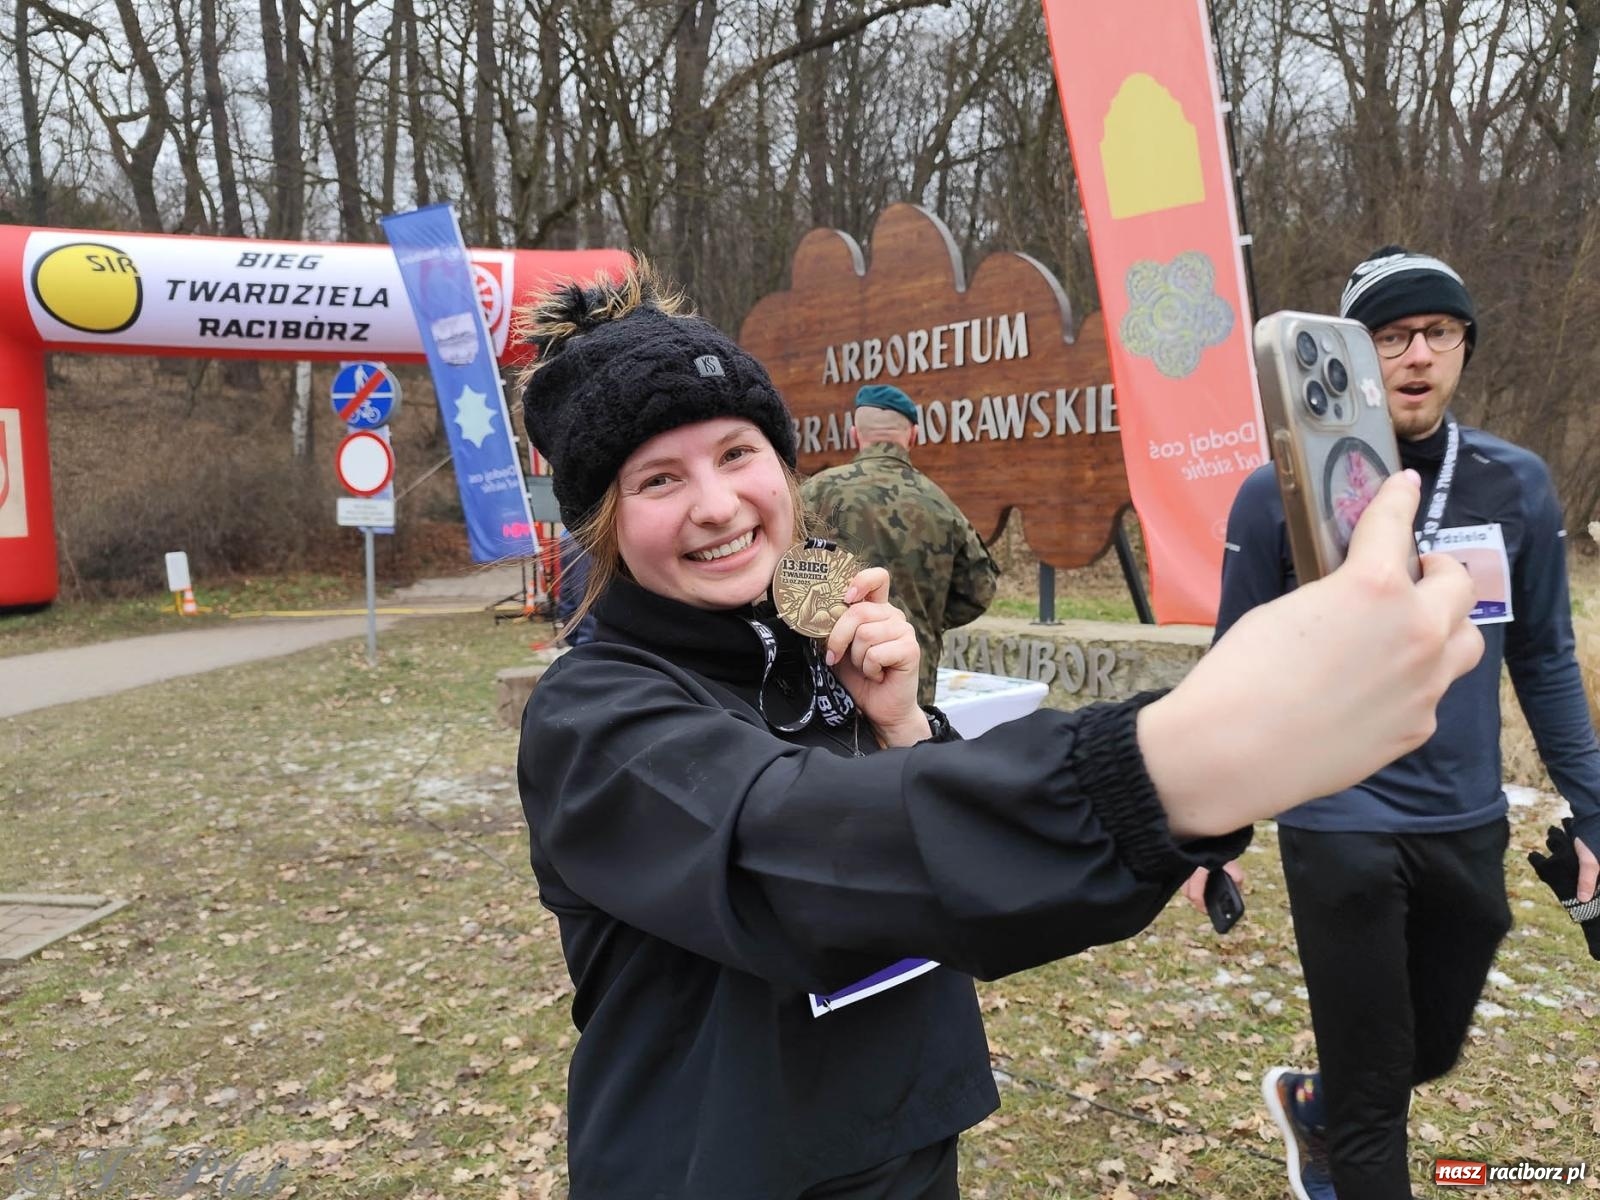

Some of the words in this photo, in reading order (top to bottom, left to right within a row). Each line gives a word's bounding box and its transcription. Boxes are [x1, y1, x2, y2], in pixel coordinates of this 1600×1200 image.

[85, 253, 138, 275] SIR
[236, 251, 323, 271] BIEG
[166, 279, 390, 308] TWARDZIELA
[198, 315, 371, 342] RACIBÓRZ
[822, 311, 1030, 385] ARBORETUM
[916, 383, 1121, 447] ORAWSKIE
[781, 571, 828, 581] TWARDZIELA
[798, 560, 829, 574] BIEG
[817, 695, 845, 727] BIE
